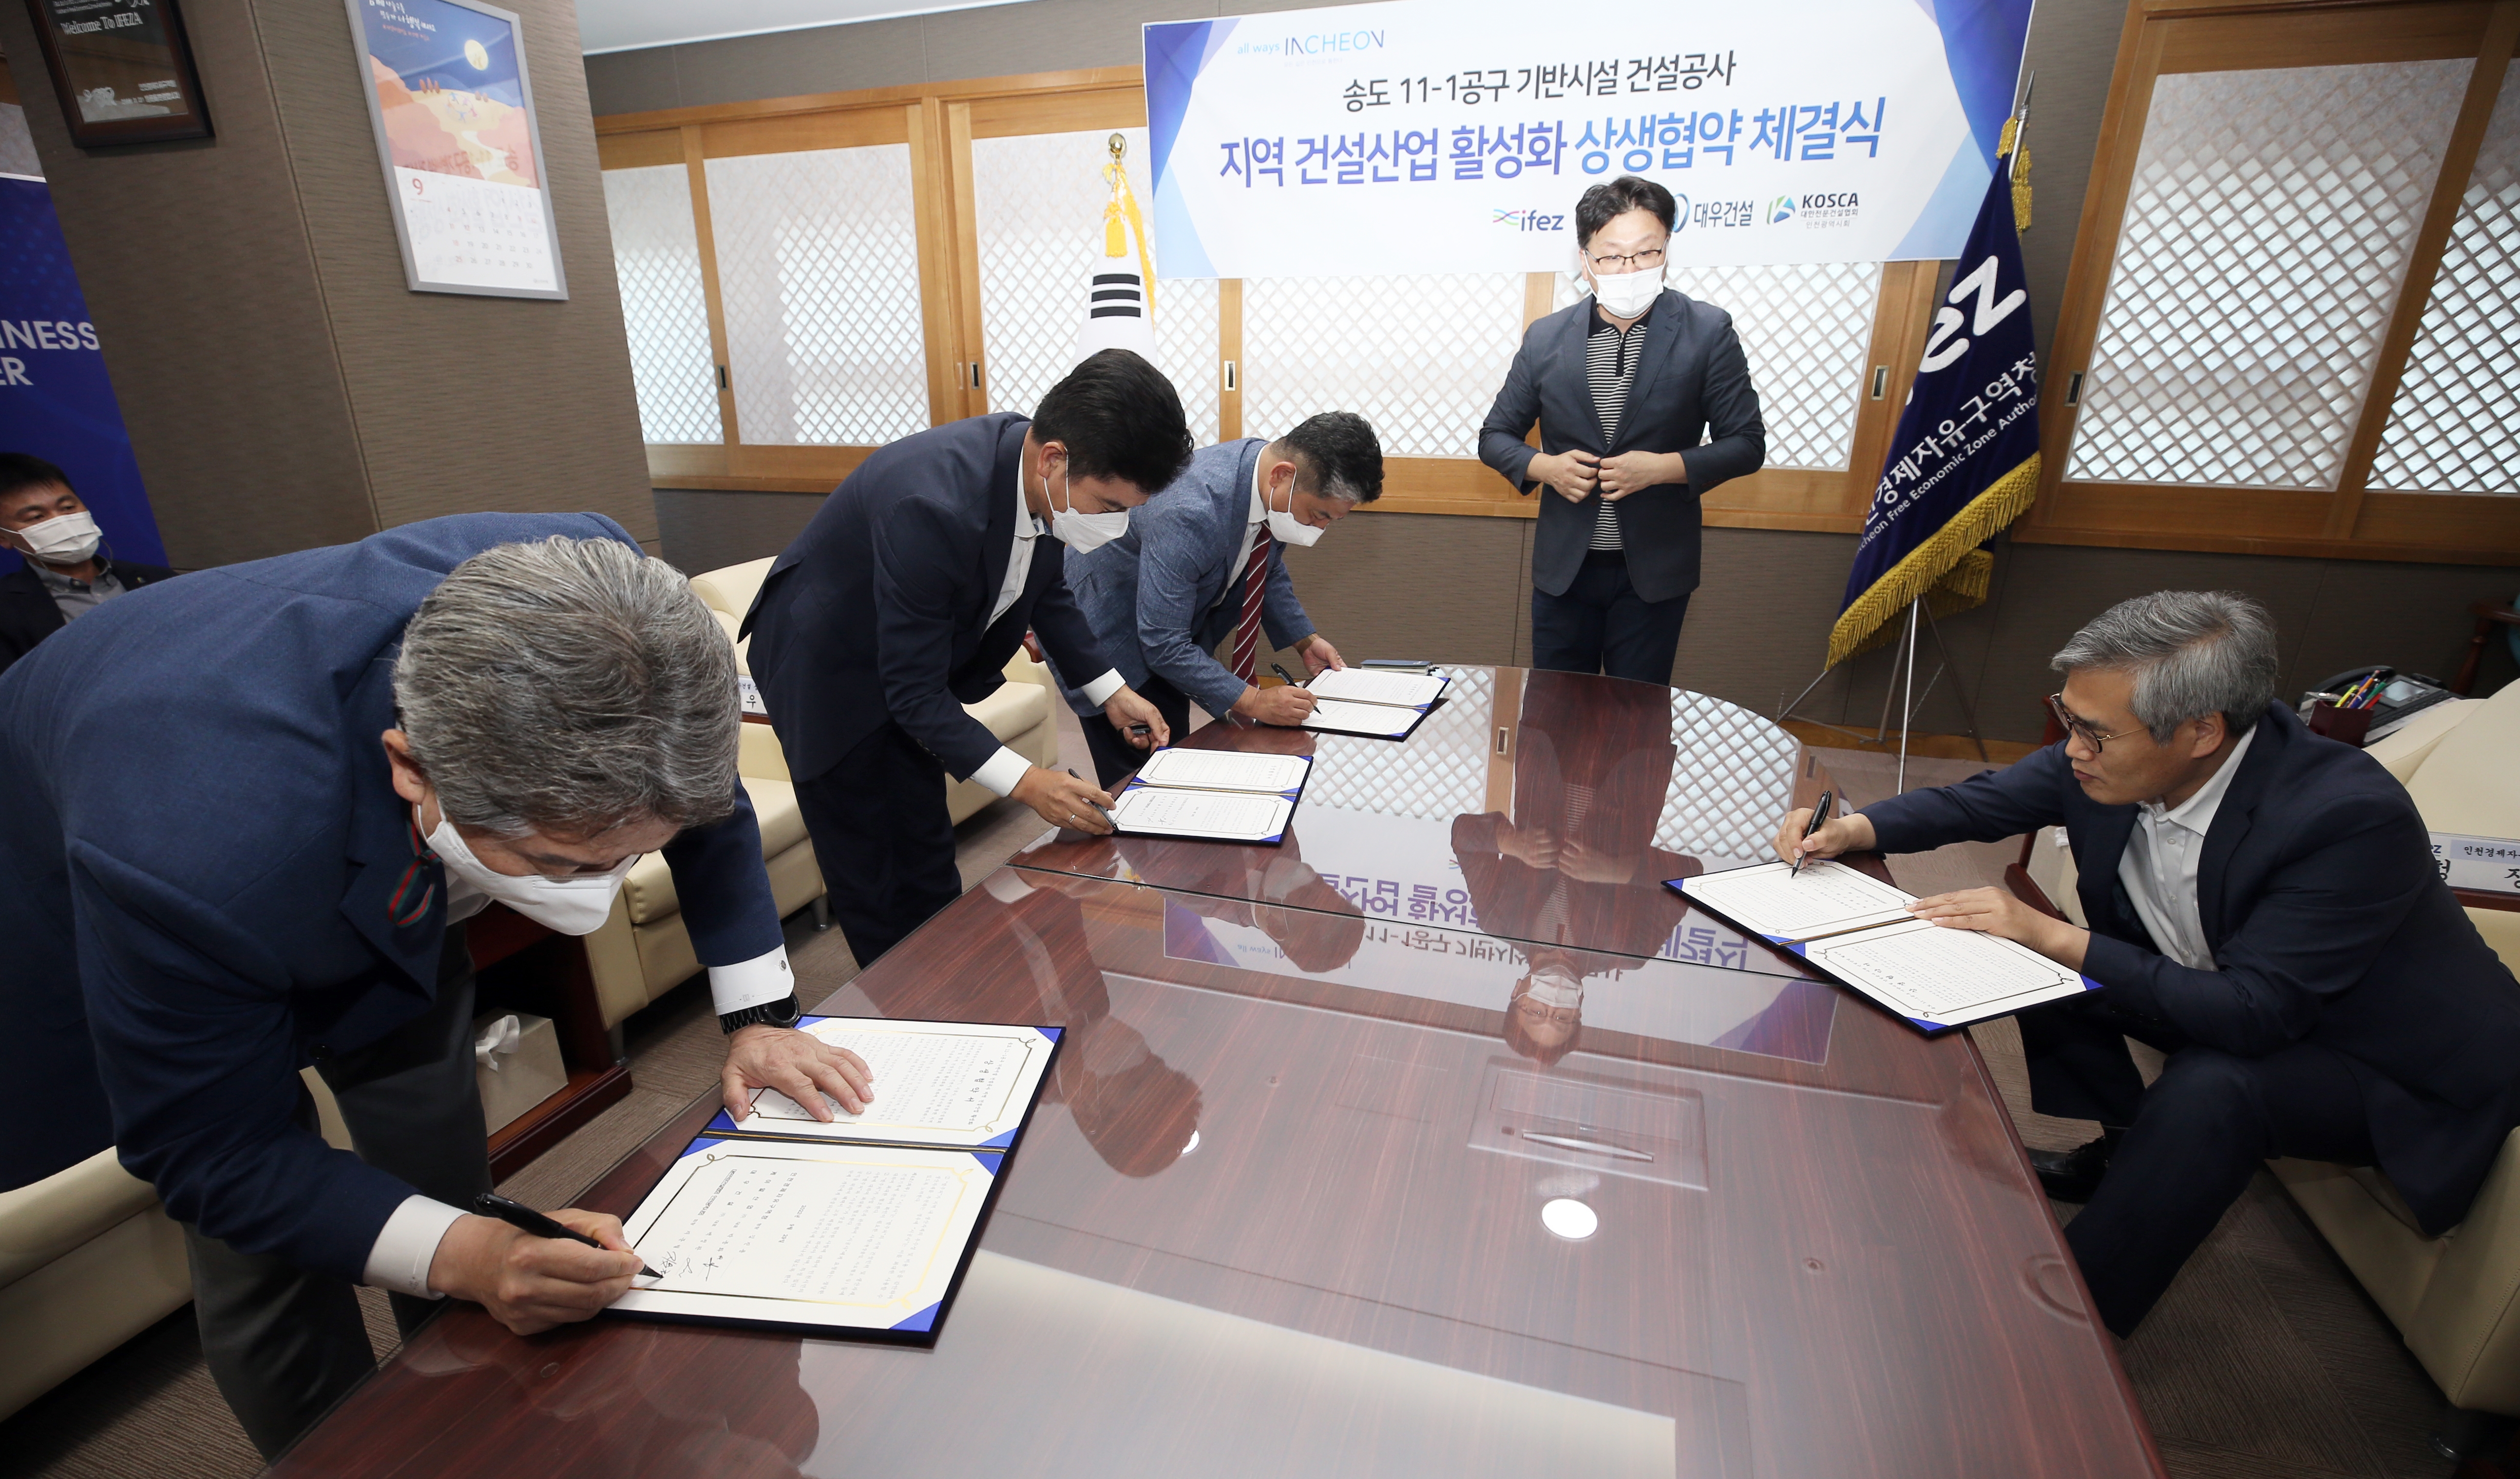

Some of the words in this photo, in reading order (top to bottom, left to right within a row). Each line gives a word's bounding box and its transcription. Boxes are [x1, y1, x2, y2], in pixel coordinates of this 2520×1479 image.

[60, 19, 102, 35] Welcome
[100, 16, 115, 29] To
[1238, 43, 1249, 54] all
[1253, 43, 1279, 55] ways
[1285, 29, 1384, 56] INCHEON
[1343, 78, 1391, 112] 송도
[1400, 69, 1510, 105] 11-1공구
[1517, 58, 1619, 99] 기반시설
[1626, 50, 1737, 93] 건설공사
[1220, 136, 1284, 188] 지역
[1295, 128, 1438, 185] 건설산업
[1449, 120, 1568, 180] 활성화
[1574, 108, 1743, 174] 상생협약
[1749, 96, 1886, 161] 체결식
[412, 178, 423, 195] 9
[1802, 192, 1859, 209] KOSCA
[1521, 209, 1564, 231] ifez
[1694, 200, 1754, 228] 대우건설
[1801, 209, 1859, 219] 대한전문건설협회
[1806, 219, 1850, 229] 인천광역시회
[1918, 255, 2026, 373] ez
[1887, 499, 1910, 521] Free
[1909, 453, 1965, 500] Economic
[1963, 428, 1997, 456] Zone
[2464, 846, 2520, 859] 인천경제자
[964, 1059, 994, 1102] 상생협약서
[793, 1204, 807, 1218] 2022년
